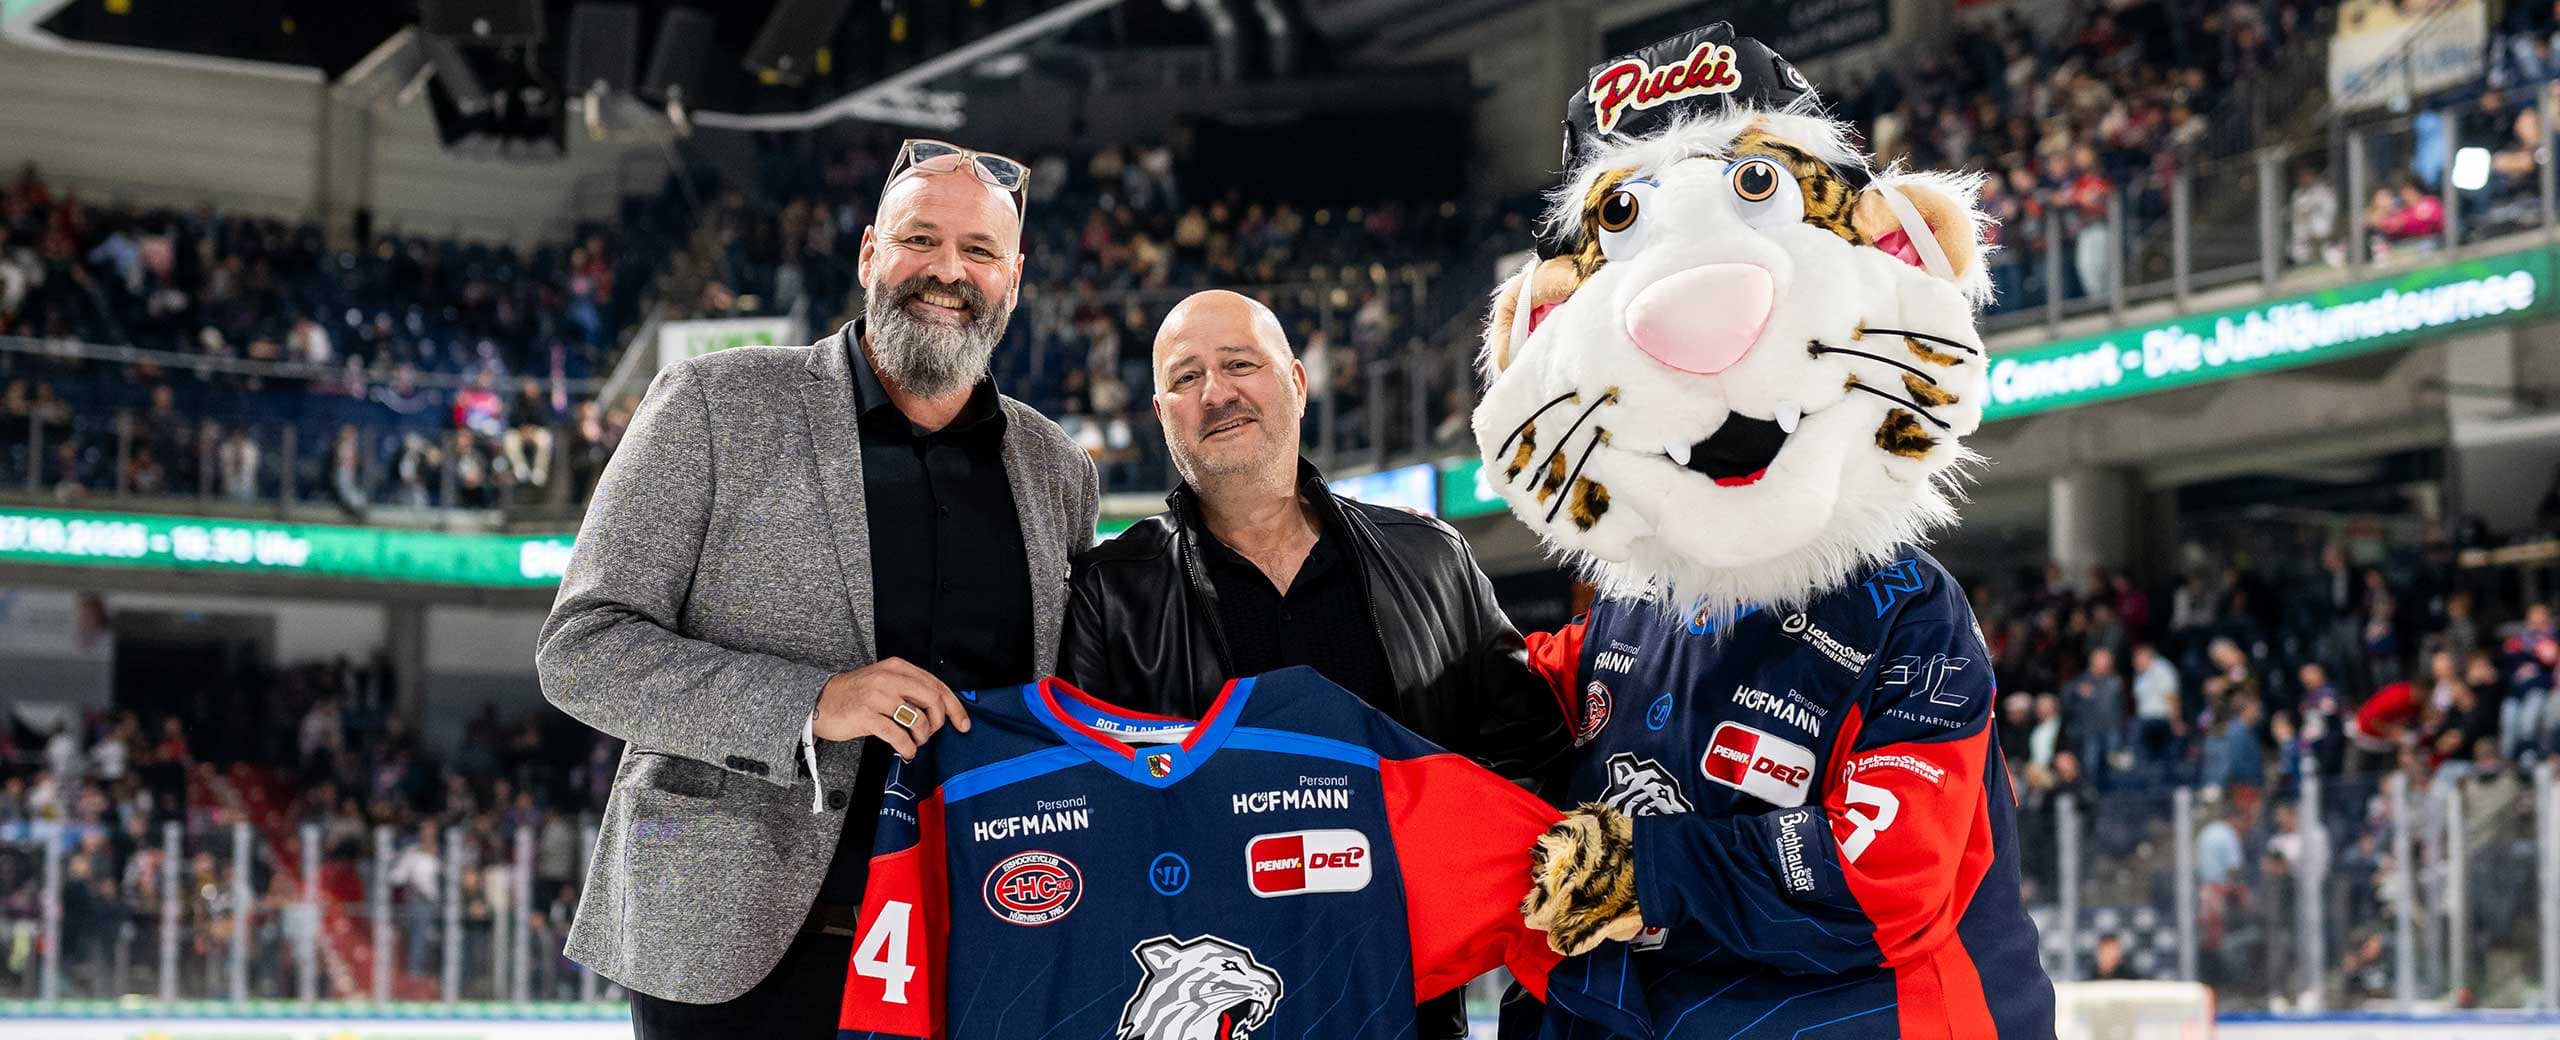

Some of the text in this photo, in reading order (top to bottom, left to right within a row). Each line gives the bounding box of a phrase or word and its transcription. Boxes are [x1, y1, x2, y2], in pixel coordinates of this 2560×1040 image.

[1591, 44, 1739, 130] Pucki
[1732, 684, 1820, 738] HOFMANN
[1787, 688, 1829, 718] Personal
[1883, 709, 1916, 722] PITAL
[1095, 717, 1120, 731] ROT
[1299, 775, 1348, 786] Personal
[1037, 795, 1087, 811] Personal
[1232, 788, 1349, 815] HOFMANN
[879, 807, 916, 825] RTNERS
[973, 808, 1089, 842] HOFMANN
[1780, 812, 1810, 891] Buchhauser
[853, 900, 916, 1004] 4
